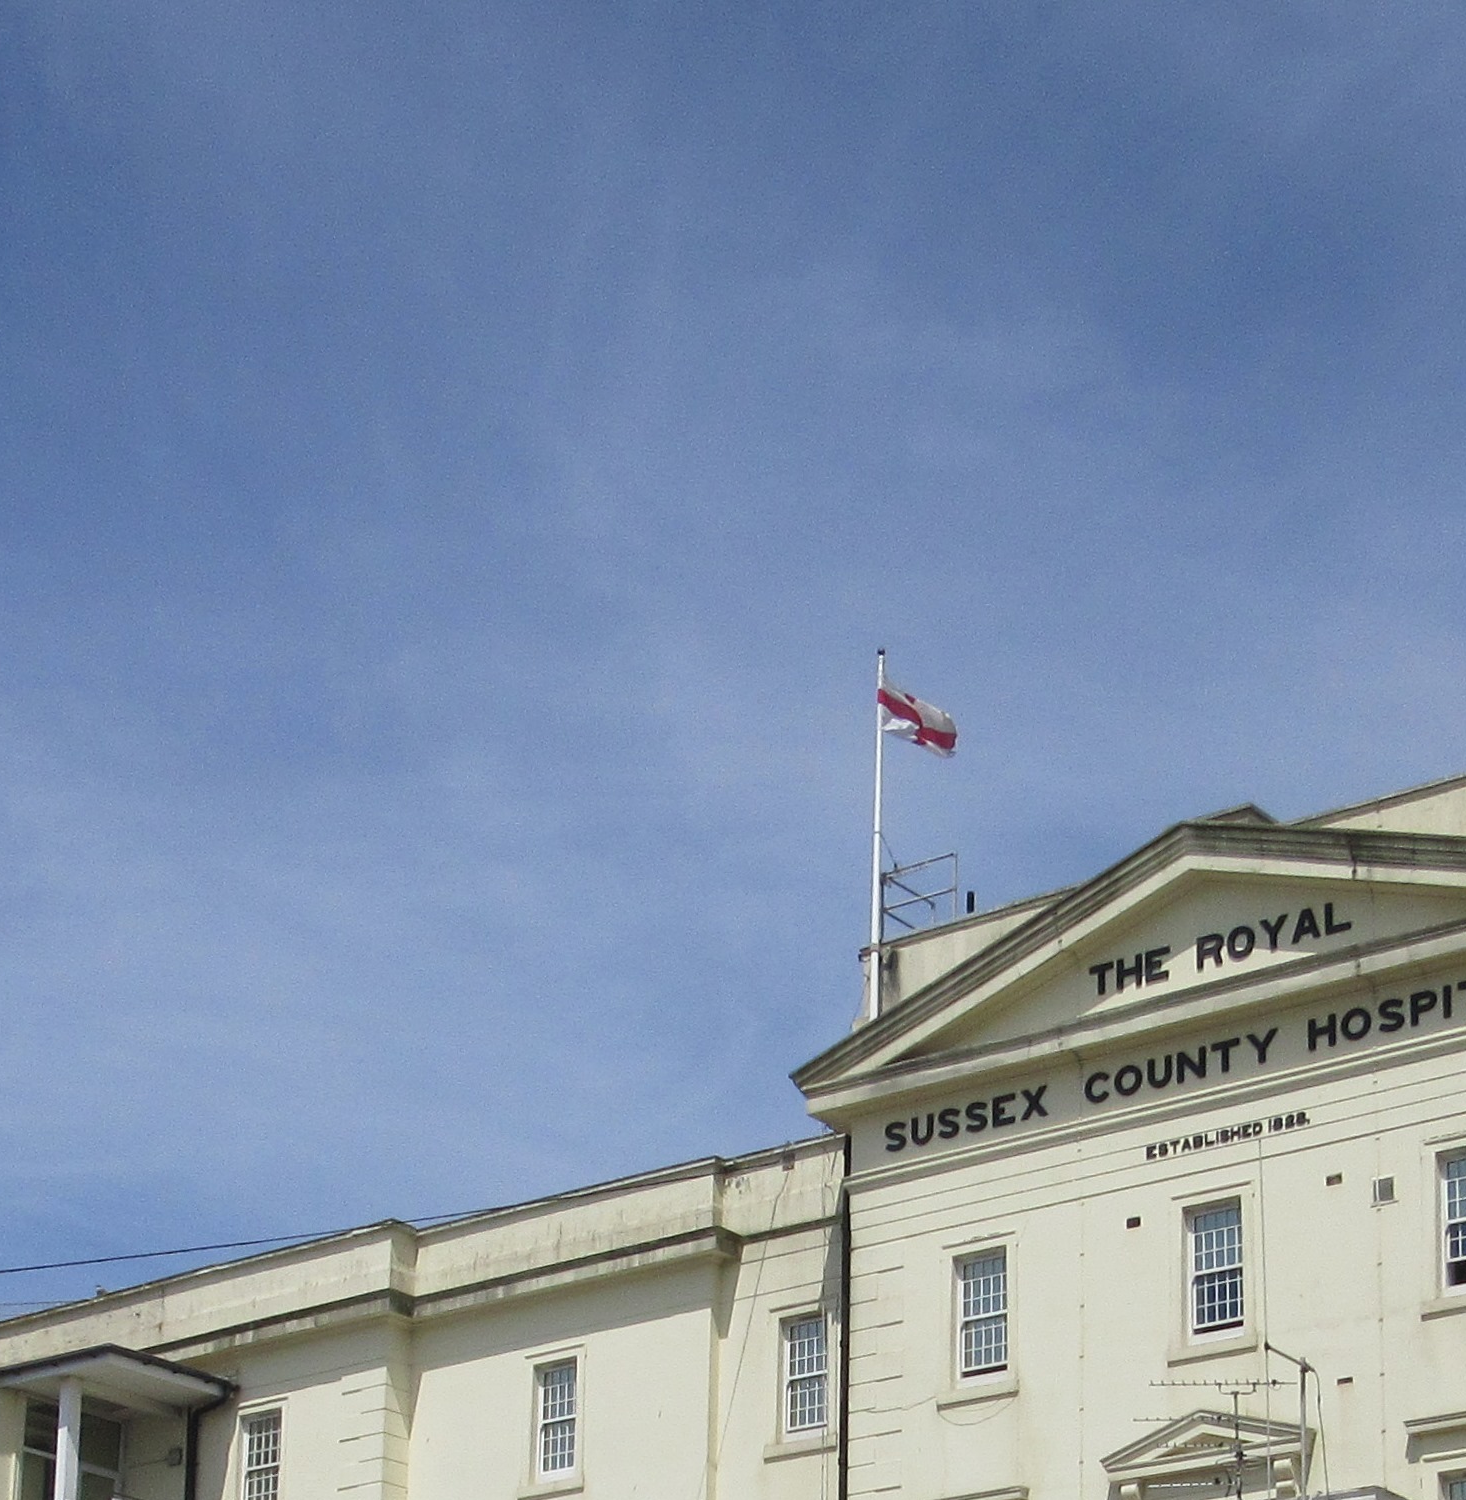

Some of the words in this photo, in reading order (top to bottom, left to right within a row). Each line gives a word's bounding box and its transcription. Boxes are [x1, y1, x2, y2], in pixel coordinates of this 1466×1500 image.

[1089, 945, 1171, 996] THE
[1196, 902, 1352, 973] ROYAL
[884, 1084, 1049, 1152] SUSSEX
[1084, 1027, 1279, 1104] COUNTY
[1146, 1122, 1263, 1161] ESTABLISHED
